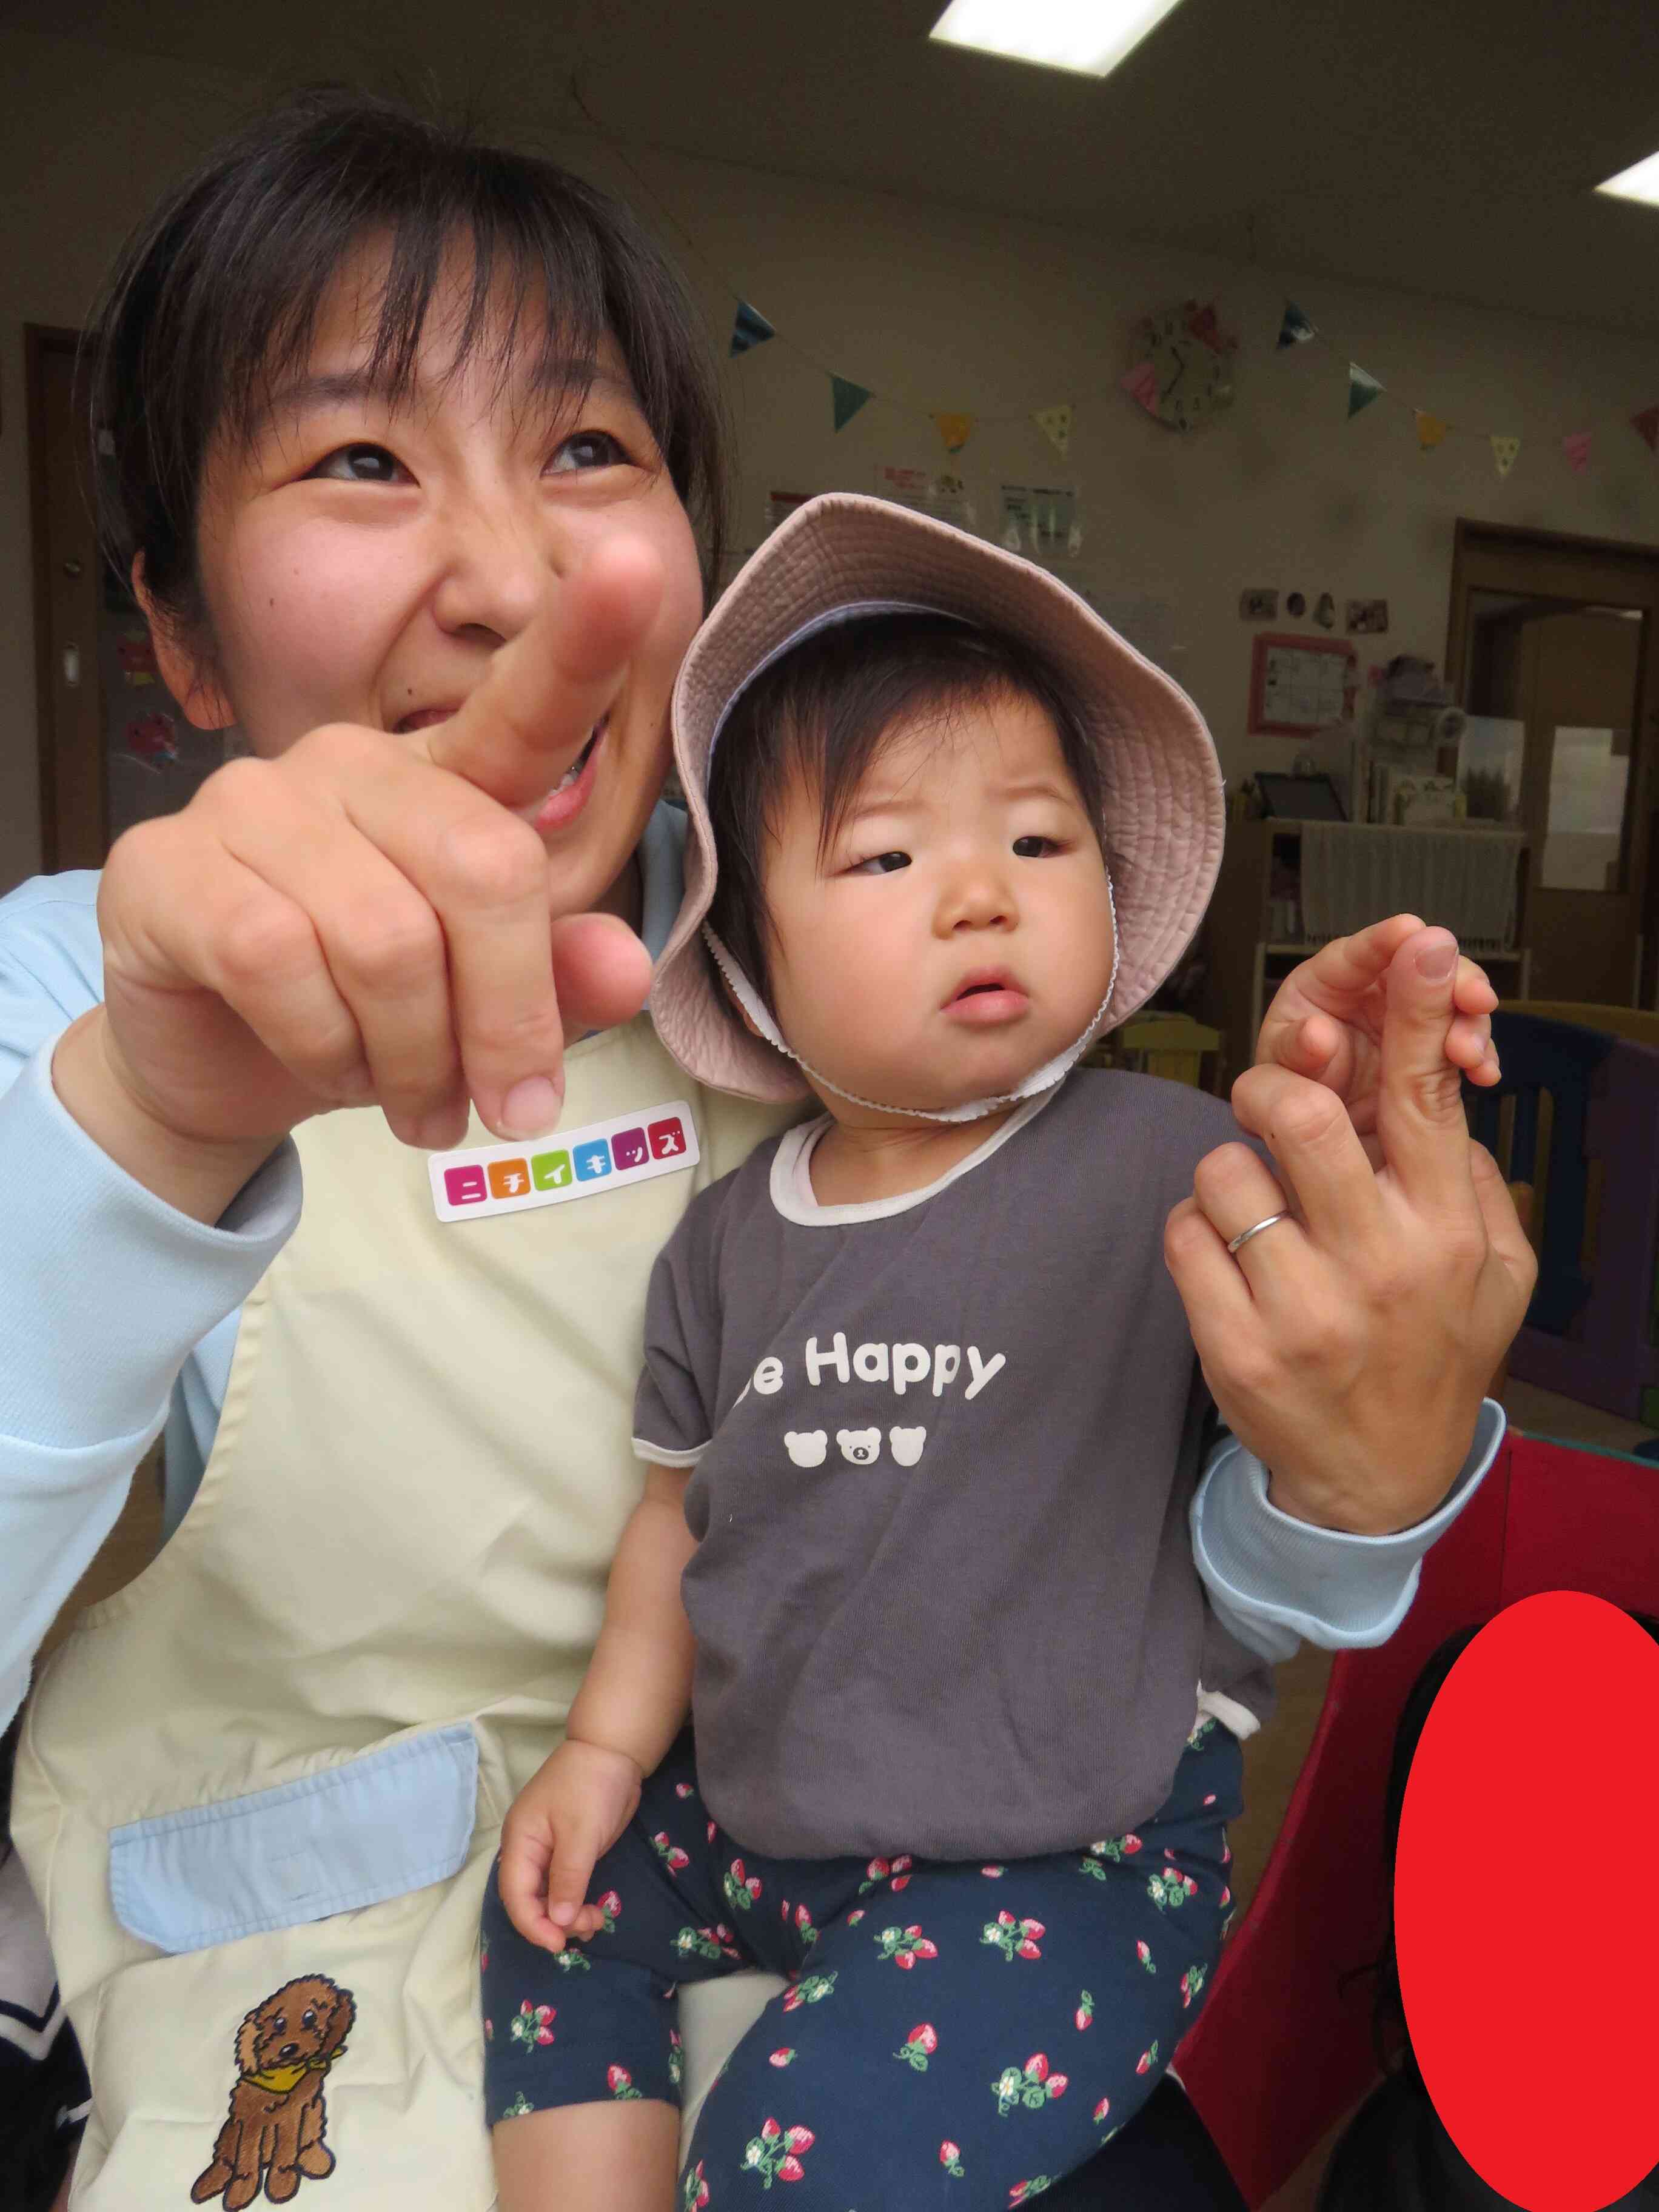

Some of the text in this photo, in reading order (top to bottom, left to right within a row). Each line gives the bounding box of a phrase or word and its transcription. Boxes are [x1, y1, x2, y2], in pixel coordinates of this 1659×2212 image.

[461, 1130, 682, 1200] ニチイキッズ
[805, 1332, 1007, 1401] Happy
